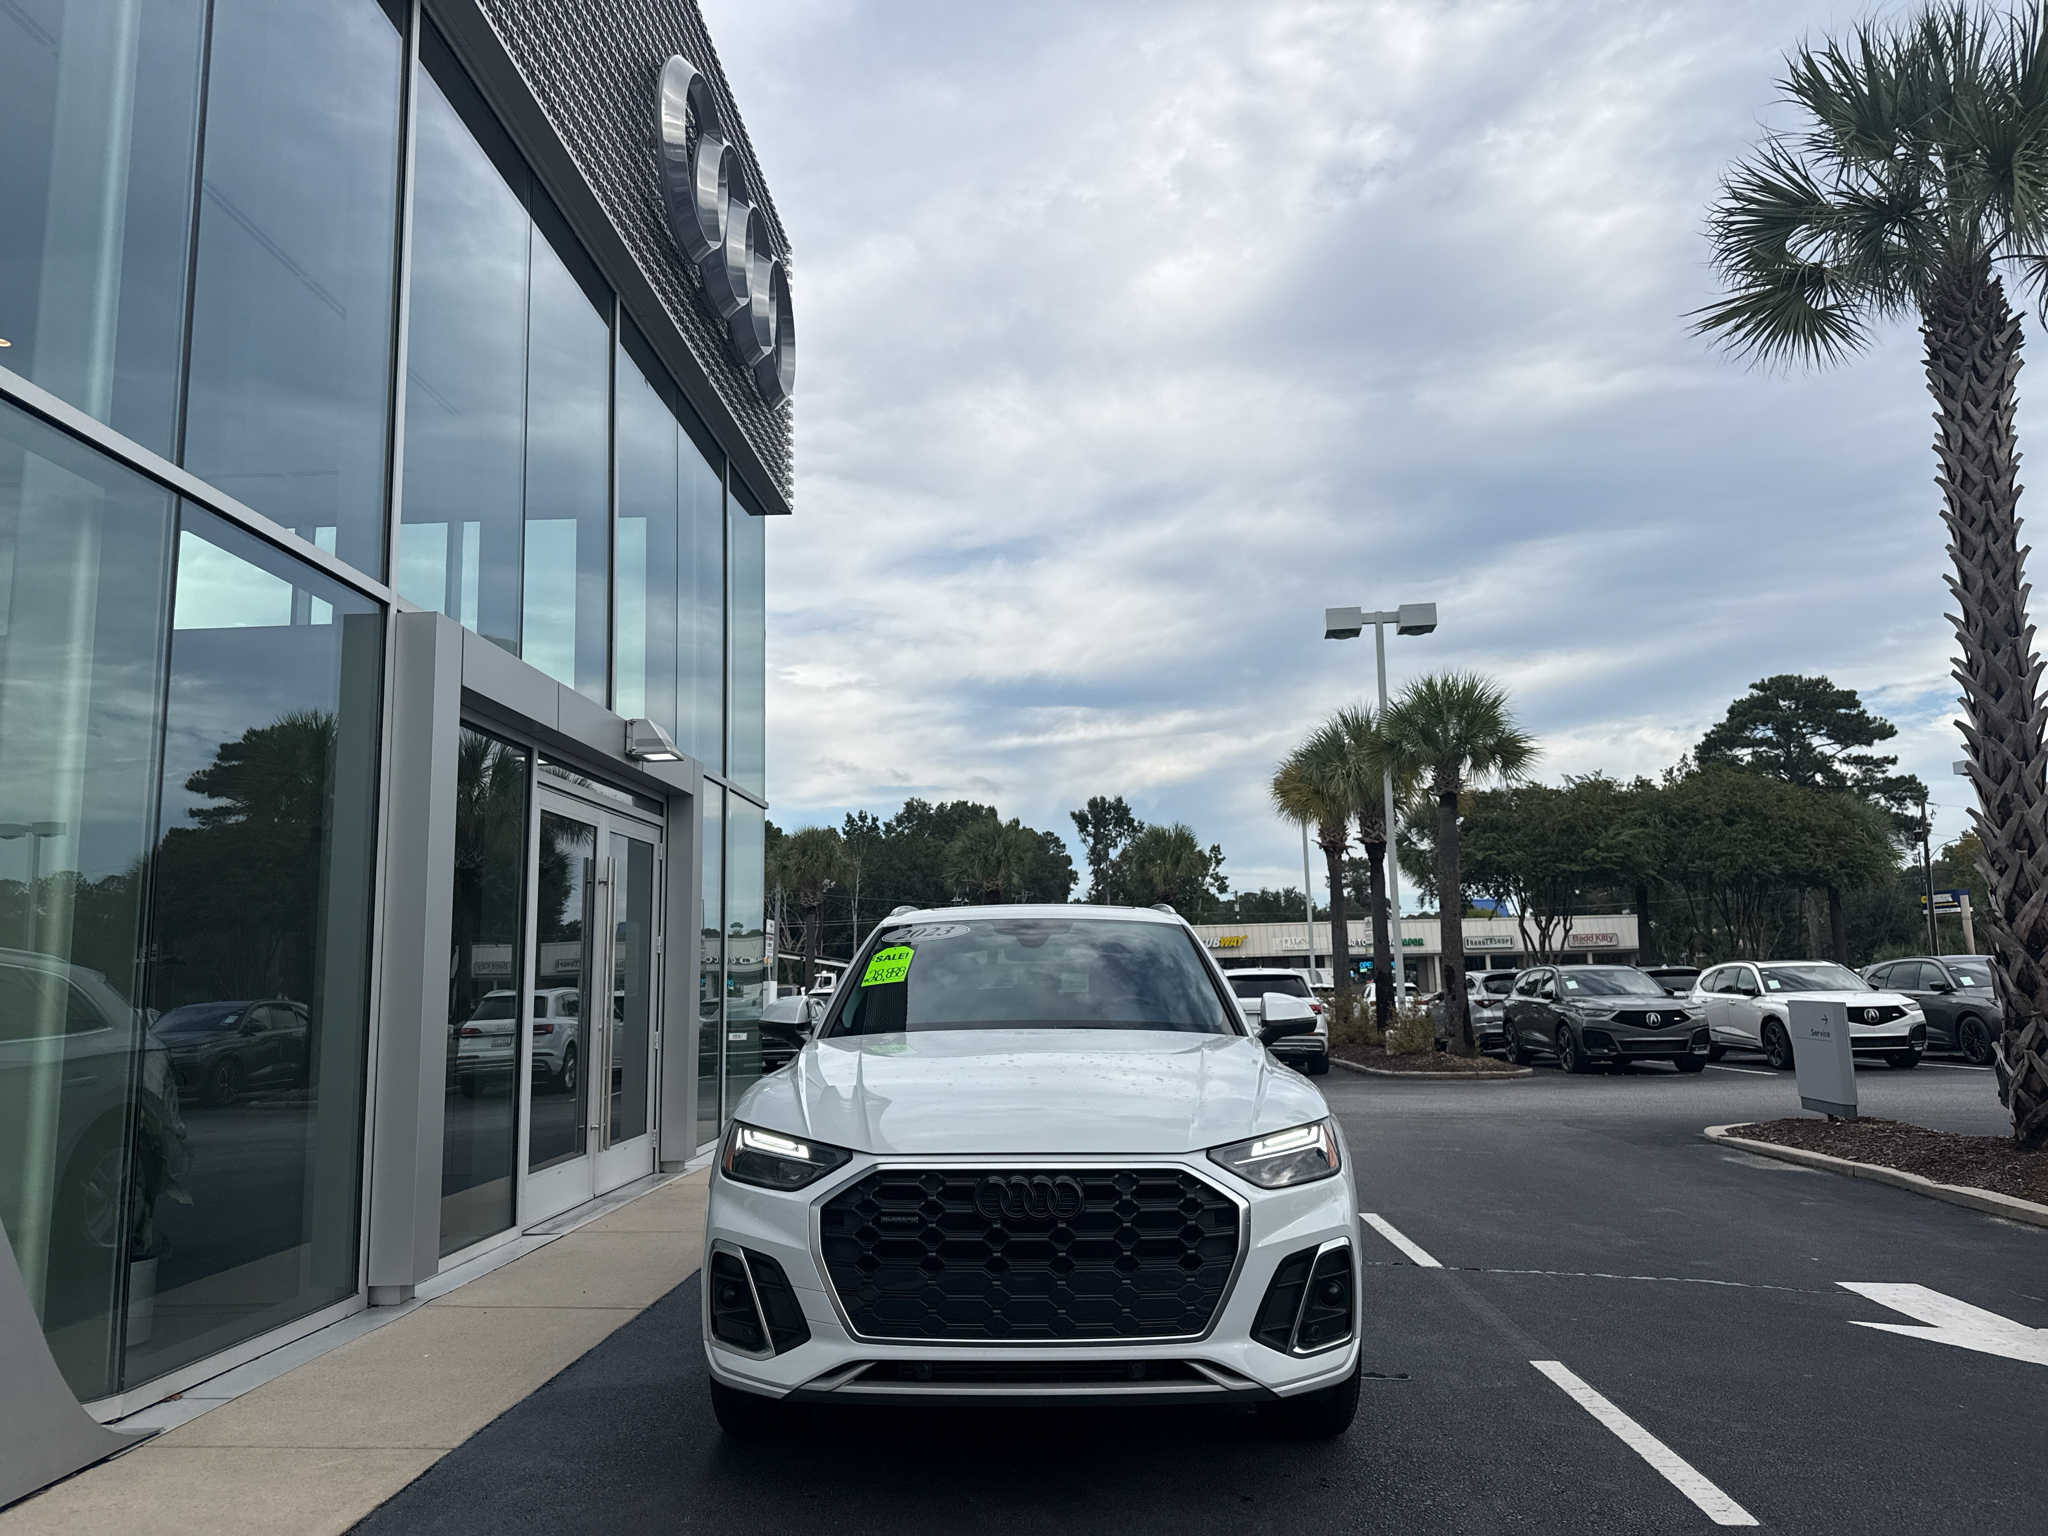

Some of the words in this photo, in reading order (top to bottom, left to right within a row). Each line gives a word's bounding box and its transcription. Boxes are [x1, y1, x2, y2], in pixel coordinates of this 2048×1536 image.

[896, 926, 956, 940] 2023
[1572, 934, 1593, 943] Badd
[875, 952, 909, 963] SALE!
[1811, 1028, 1831, 1038] Service
